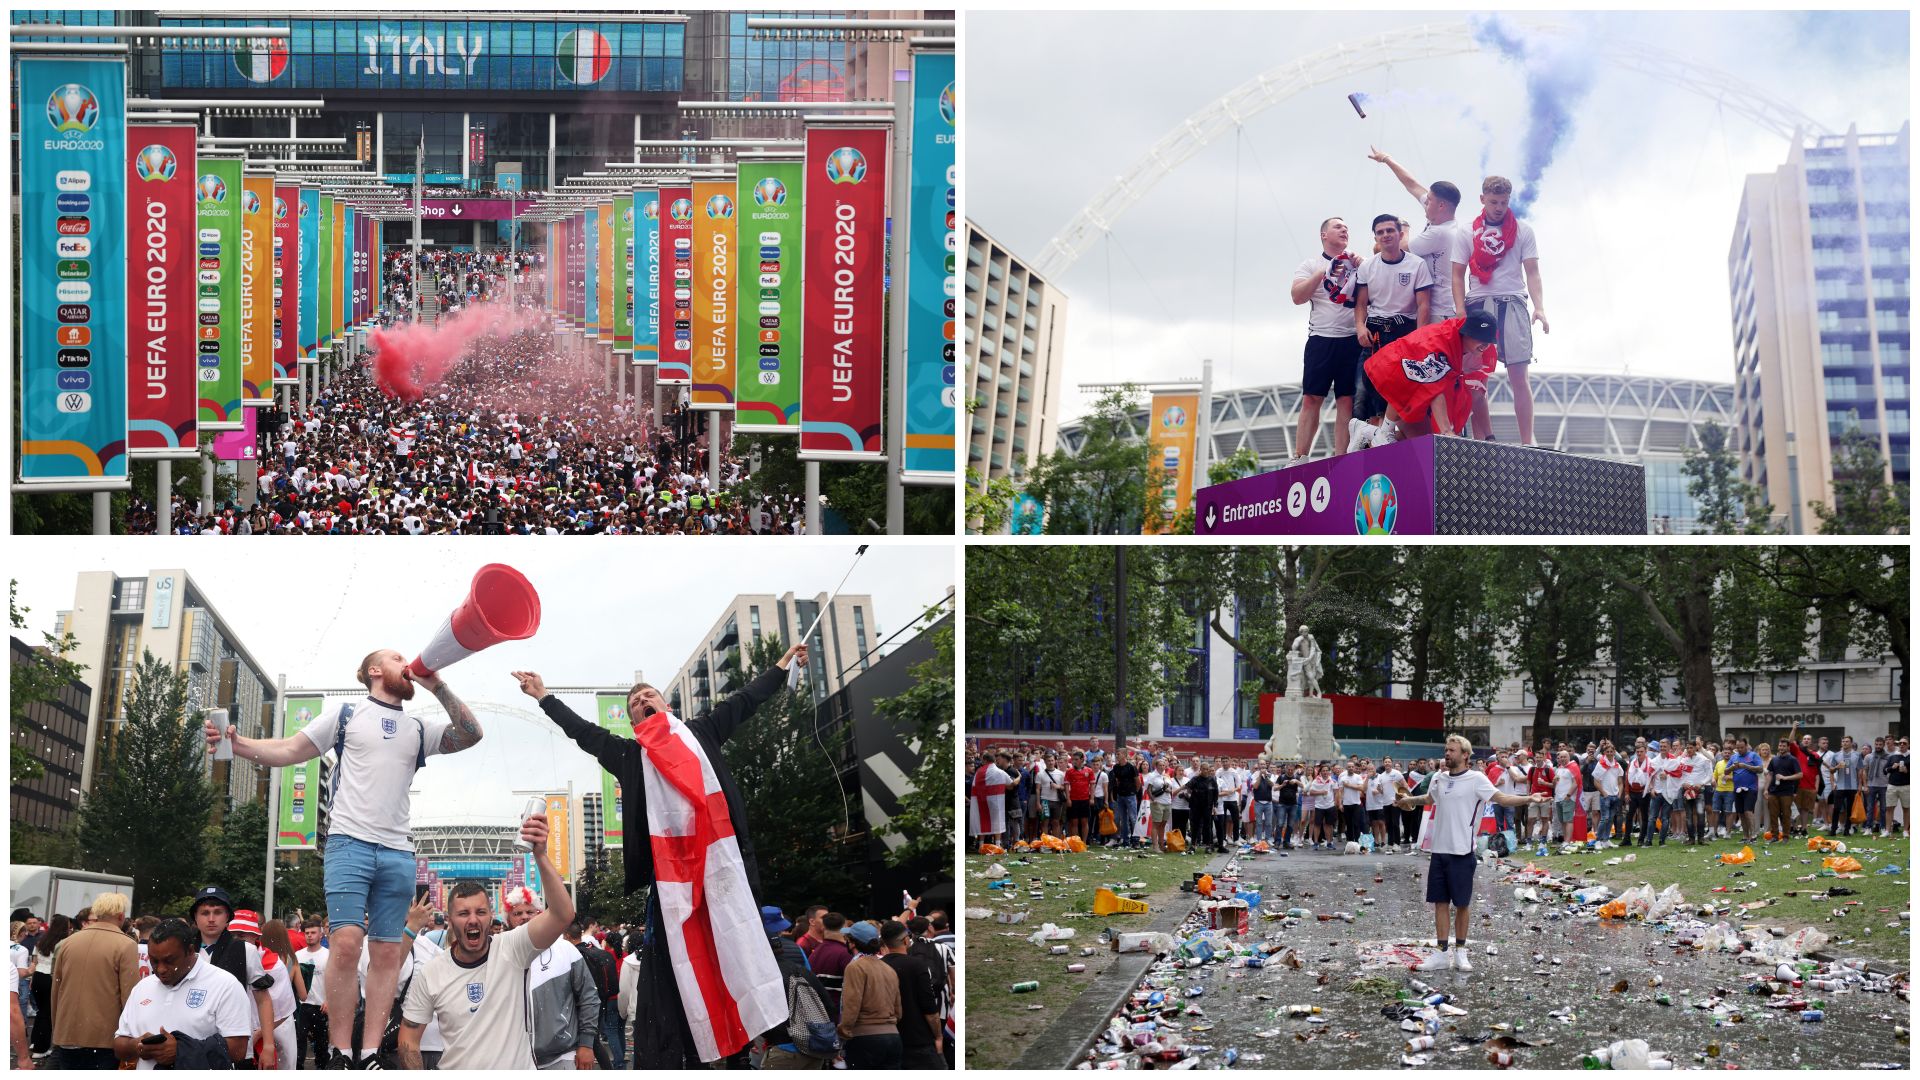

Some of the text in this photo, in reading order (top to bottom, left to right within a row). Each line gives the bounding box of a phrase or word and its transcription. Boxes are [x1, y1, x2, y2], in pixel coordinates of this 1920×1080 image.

[363, 35, 482, 75] ITALY
[68, 177, 87, 185] Alipay
[60, 243, 87, 252] FedEx
[60, 307, 87, 318] QATAR
[147, 267, 166, 331] EURO
[713, 278, 726, 323] EURO
[833, 269, 854, 334] EURO
[66, 355, 89, 363] TikTok
[147, 336, 166, 399] UEFA
[712, 325, 726, 370] UEFA
[832, 338, 853, 402] UEFA
[1223, 485, 1325, 523] Entrances 2 4
